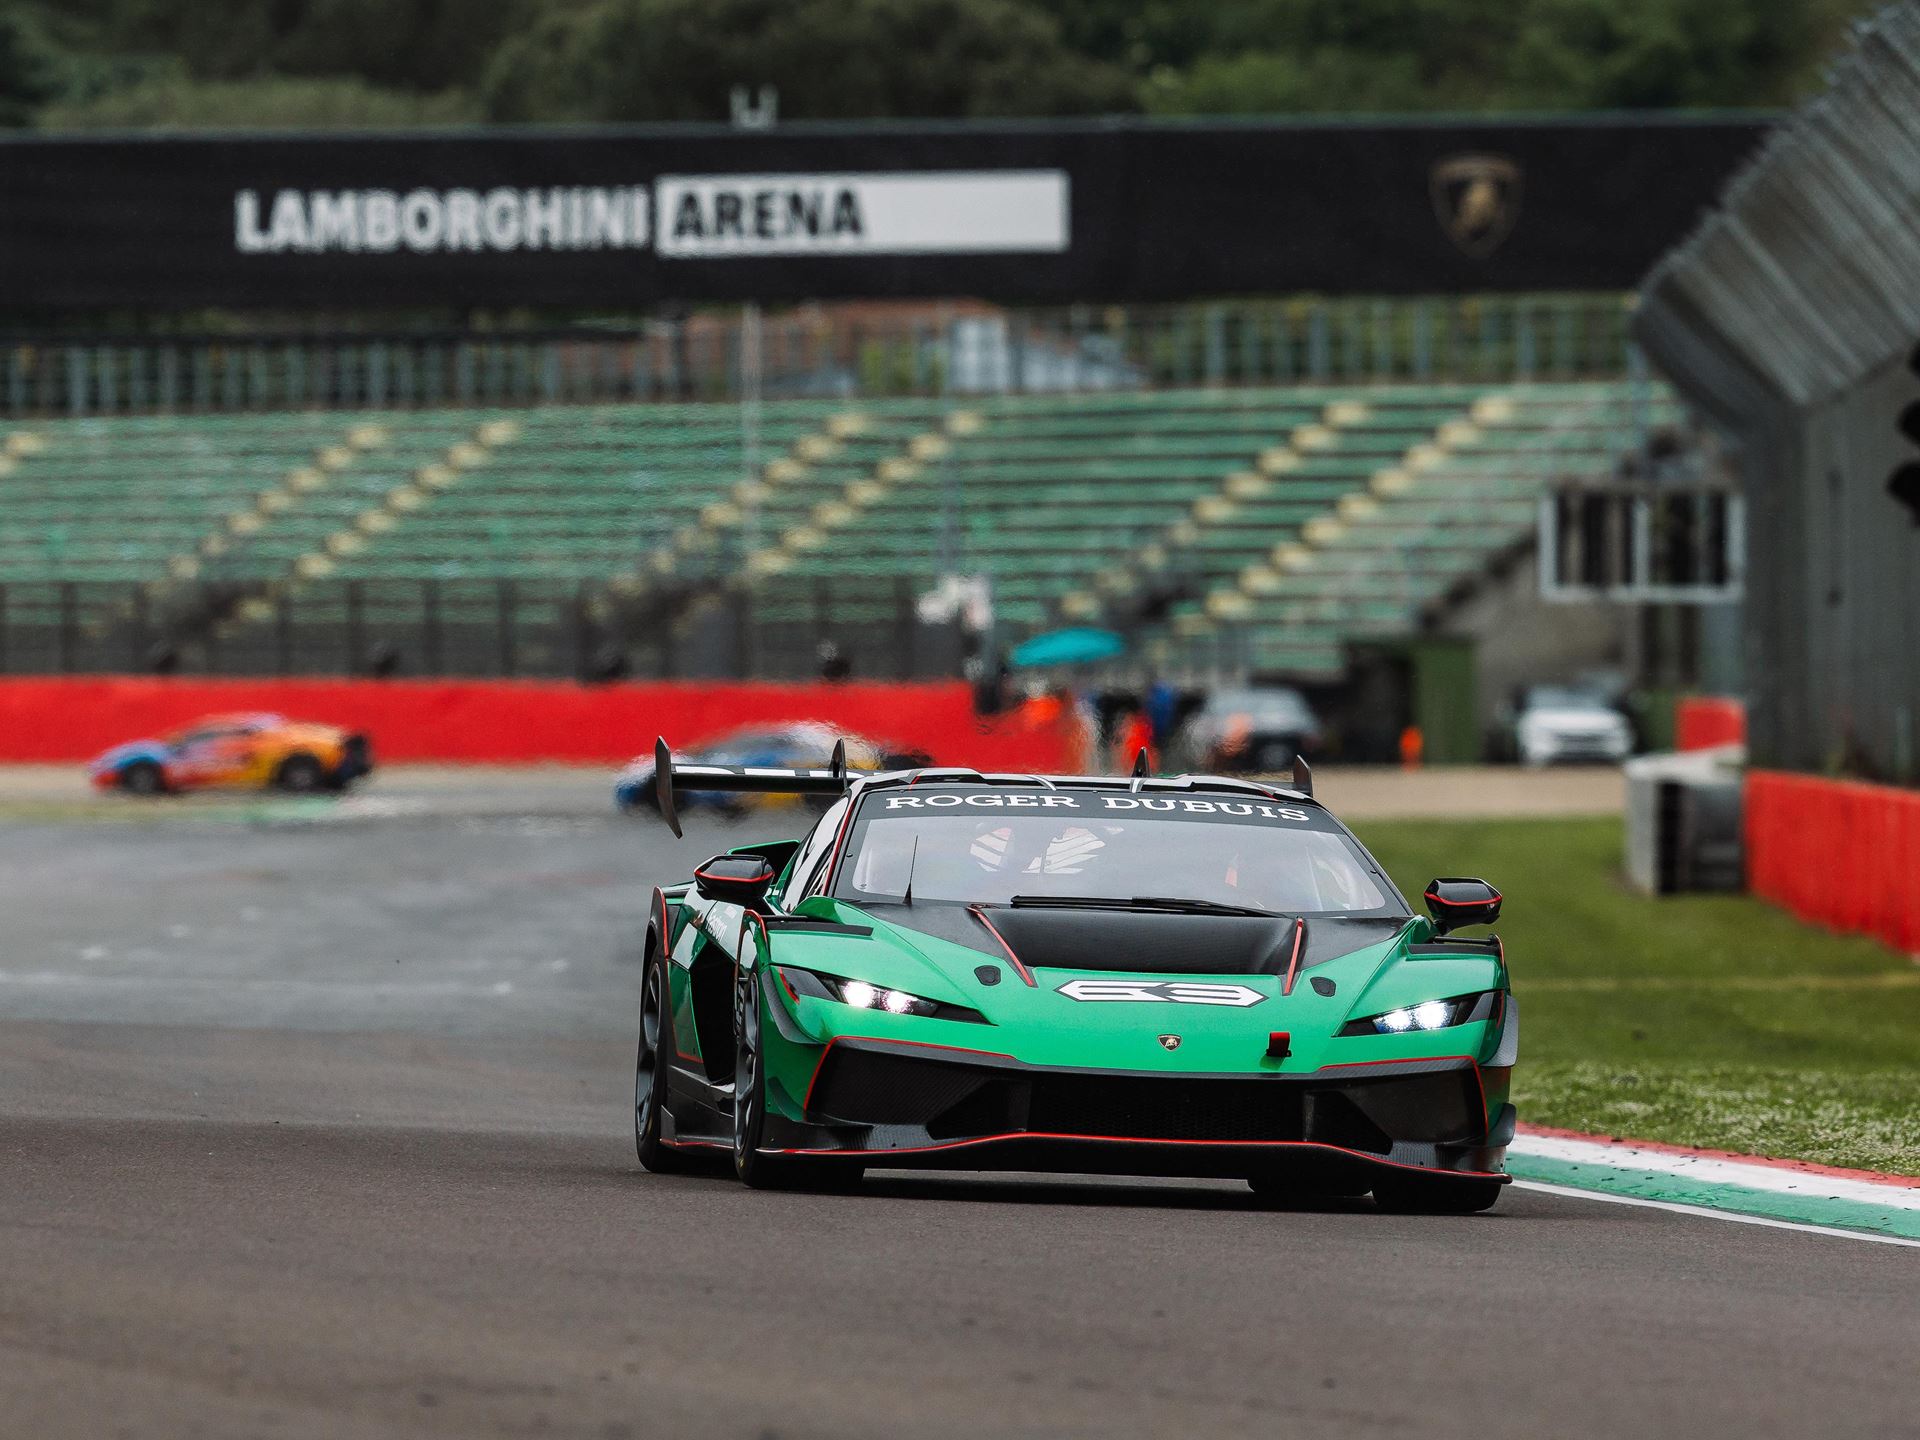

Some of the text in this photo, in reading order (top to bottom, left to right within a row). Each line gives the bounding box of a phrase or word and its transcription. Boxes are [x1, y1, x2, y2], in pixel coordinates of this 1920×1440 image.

[235, 188, 864, 253] LAMBORGHINI ARENA
[886, 795, 1310, 821] ROGER DUBUIS
[1056, 980, 1267, 1007] 63
